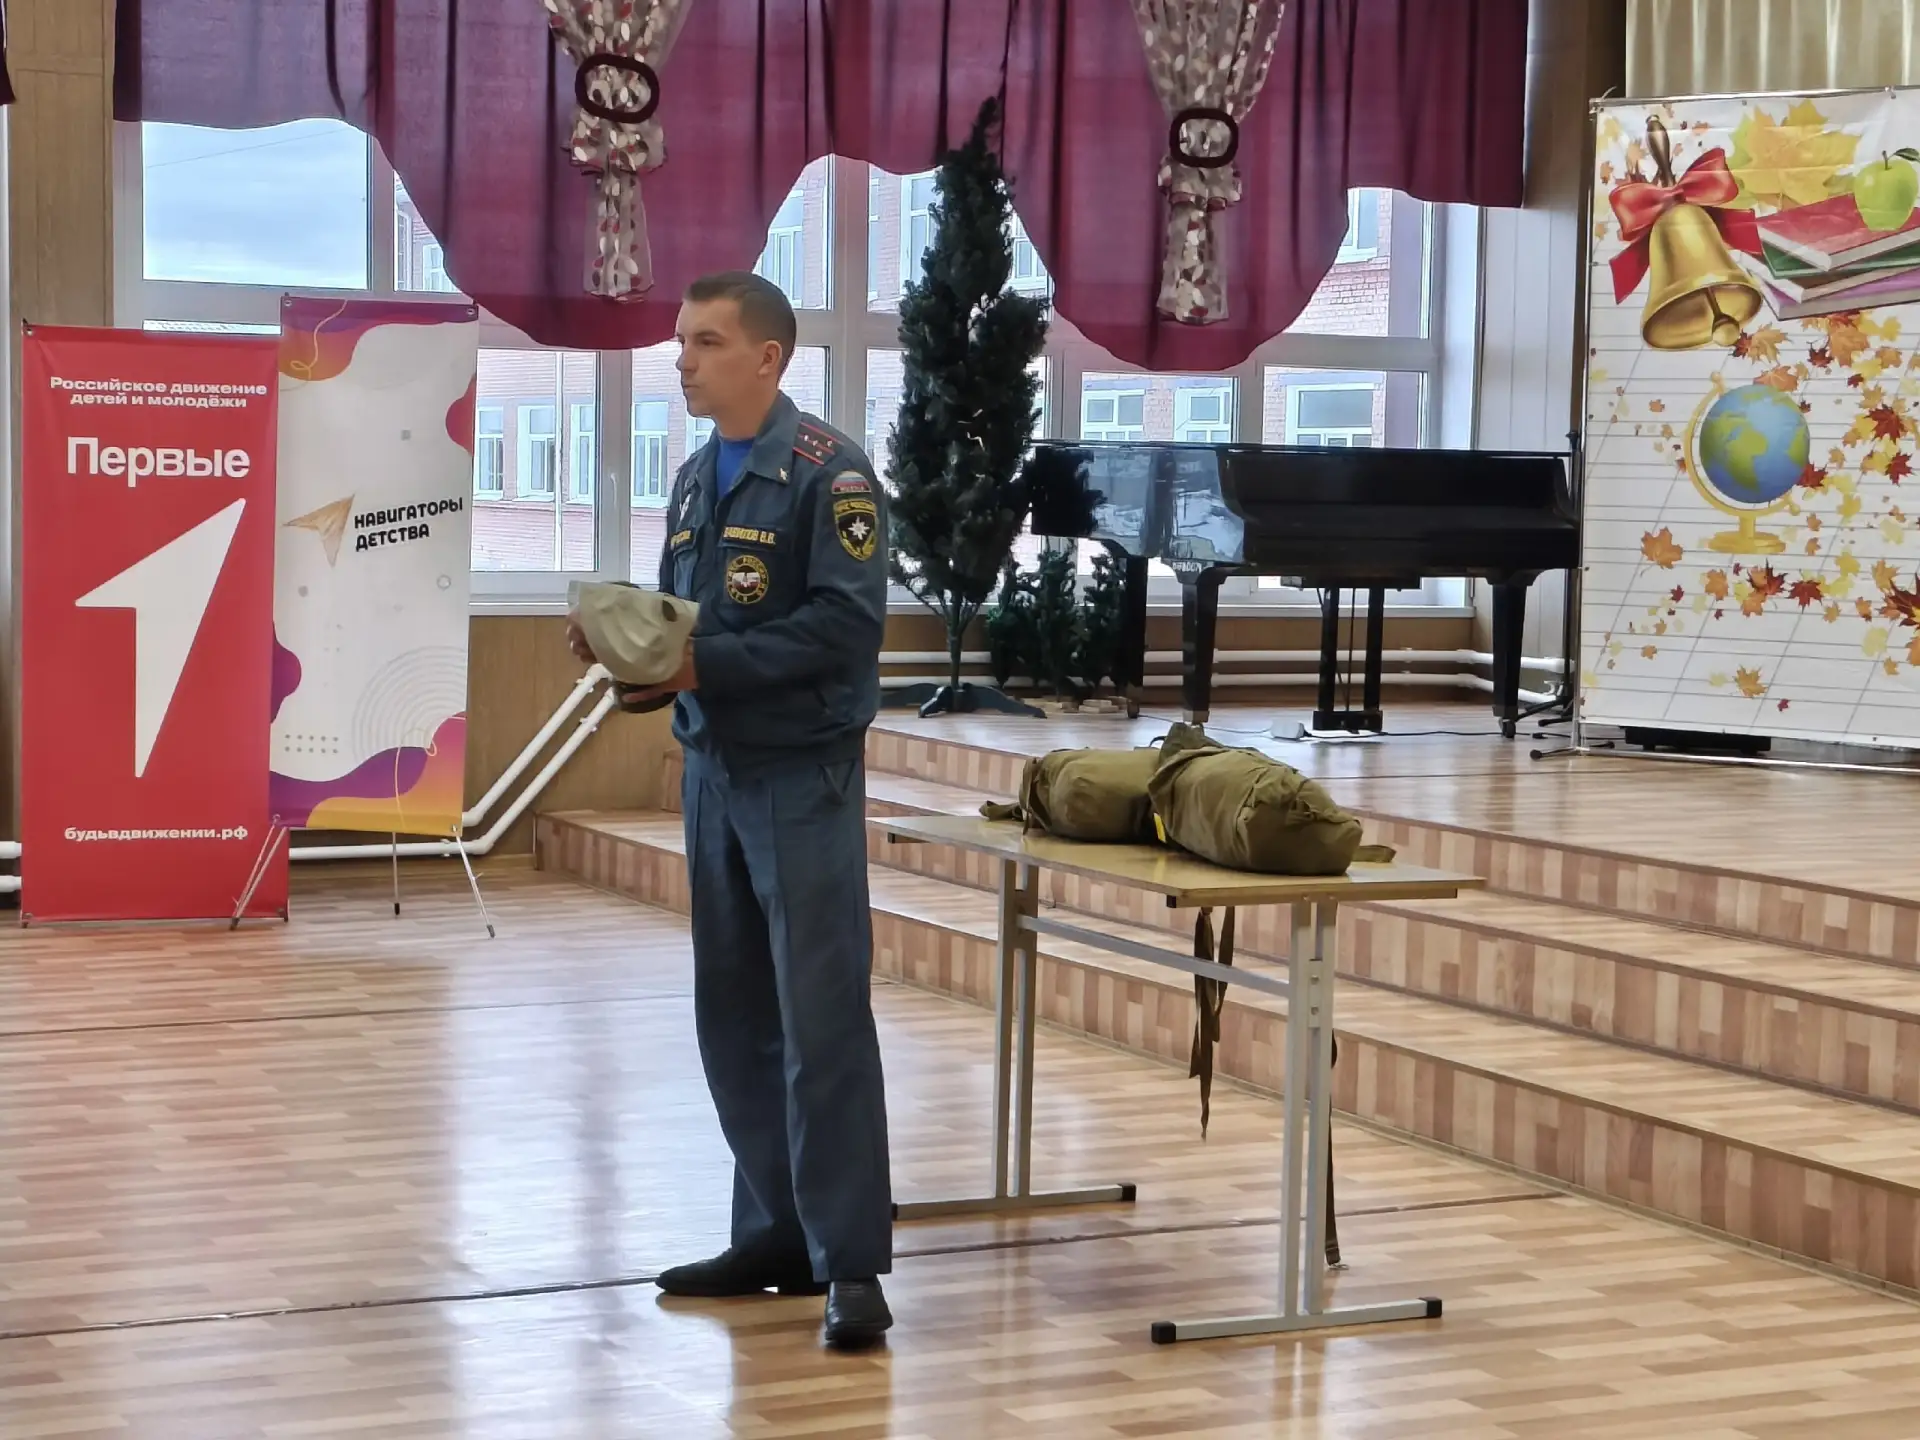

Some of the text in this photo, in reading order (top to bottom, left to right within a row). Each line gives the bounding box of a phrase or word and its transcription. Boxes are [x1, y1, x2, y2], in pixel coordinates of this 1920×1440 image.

[50, 376, 267, 396] Российское движение
[70, 392, 247, 409] детей и молодёжи
[67, 436, 250, 488] Первые
[354, 497, 463, 529] НАВИГАТОРЫ
[355, 523, 430, 552] ДЕТСТВА
[64, 825, 248, 842] будьвдвижении.рф
